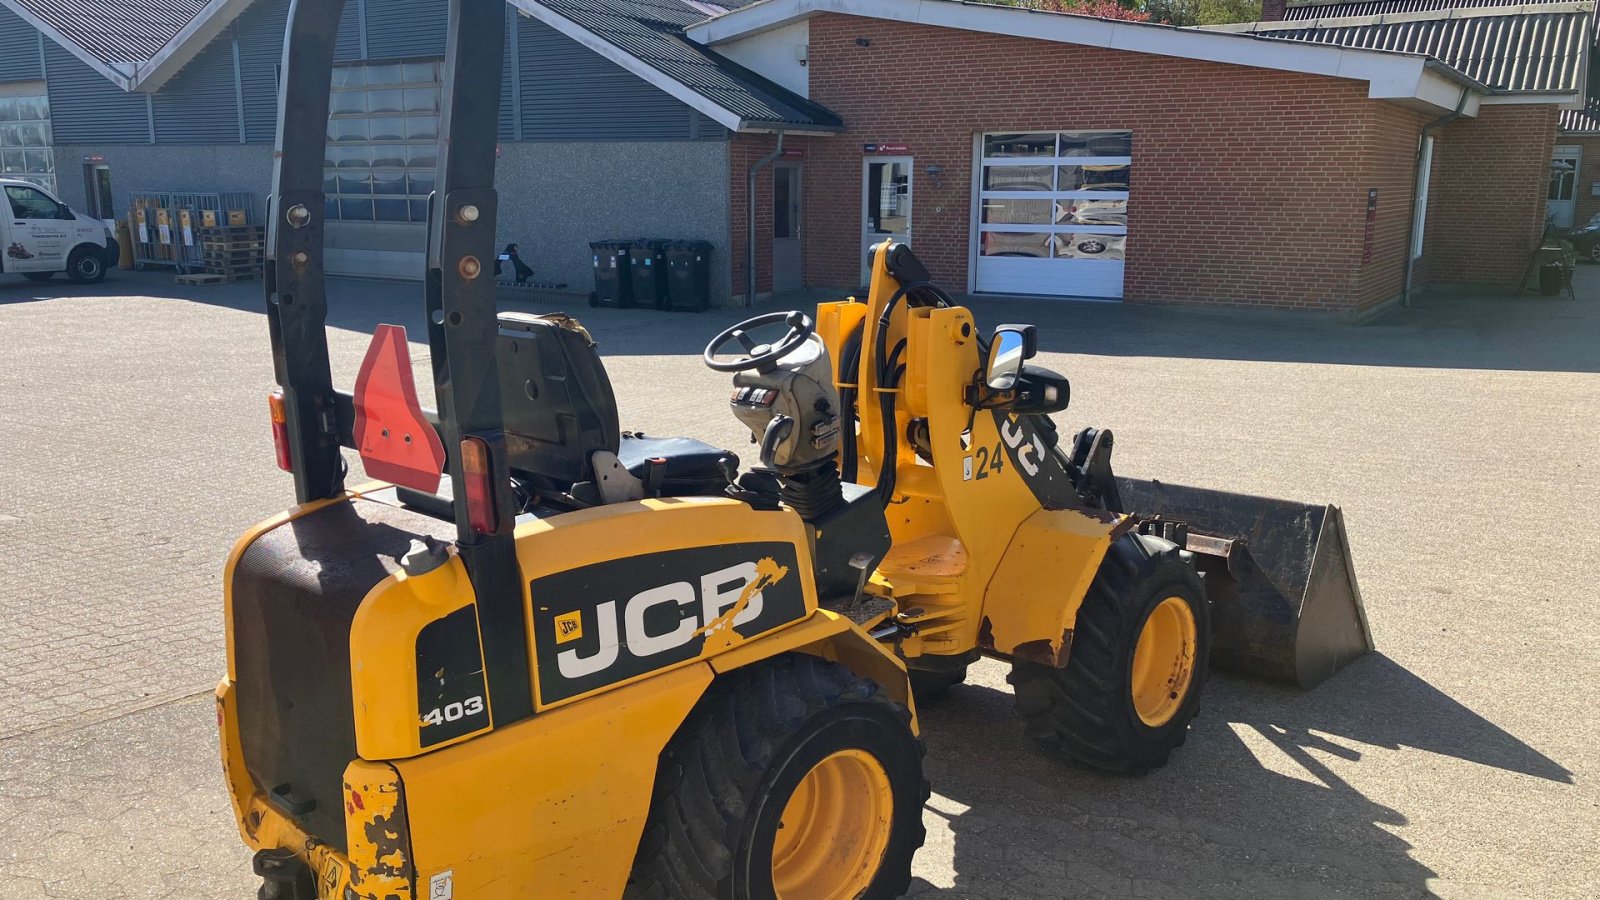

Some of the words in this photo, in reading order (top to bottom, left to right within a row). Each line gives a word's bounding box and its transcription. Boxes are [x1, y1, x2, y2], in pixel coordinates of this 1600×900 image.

[975, 442, 1003, 481] 24
[557, 561, 764, 679] JCB
[562, 620, 578, 635] JCB
[422, 696, 485, 727] 403
